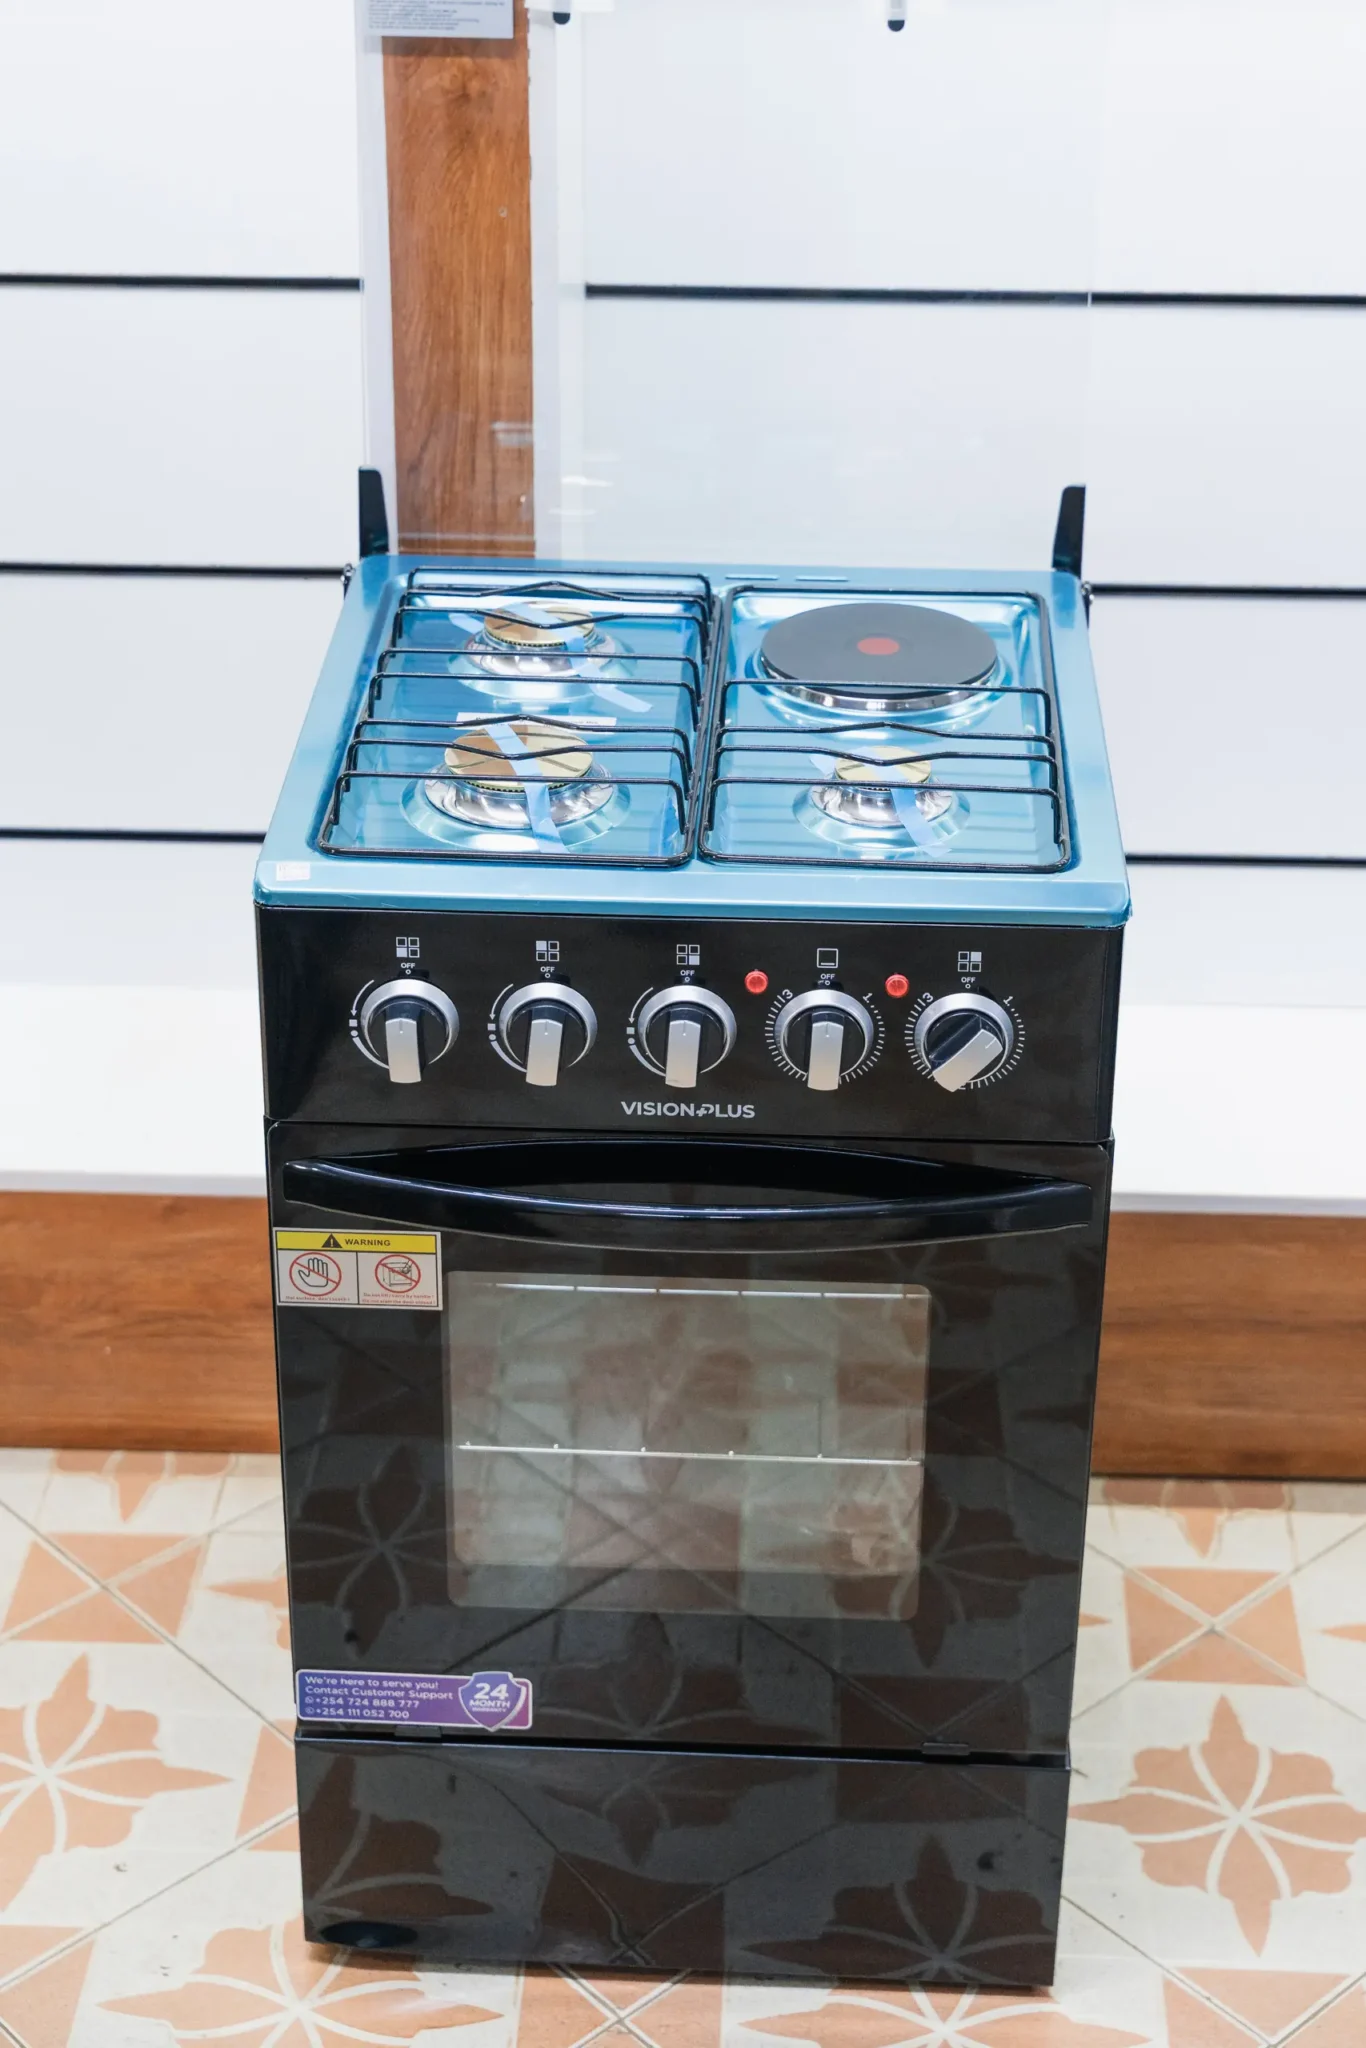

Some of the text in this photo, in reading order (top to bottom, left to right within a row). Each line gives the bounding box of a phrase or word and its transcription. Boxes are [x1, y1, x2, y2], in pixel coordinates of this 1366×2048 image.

[401, 962, 415, 970] OFF
[680, 969, 695, 977] OFF
[782, 989, 793, 999] 3
[862, 992, 873, 1003] 1
[922, 992, 934, 1002] 3
[1003, 996, 1013, 1006] 1
[344, 1238, 391, 1247] WARNING
[305, 1676, 439, 1691] We're here to serve you!
[305, 1685, 454, 1700] Contact Customer Support
[474, 1682, 509, 1700] 24
[316, 1696, 420, 1709] +254 724 888 777
[469, 1699, 511, 1709] MONTH
[316, 1707, 410, 1719] +254 111 052 700
